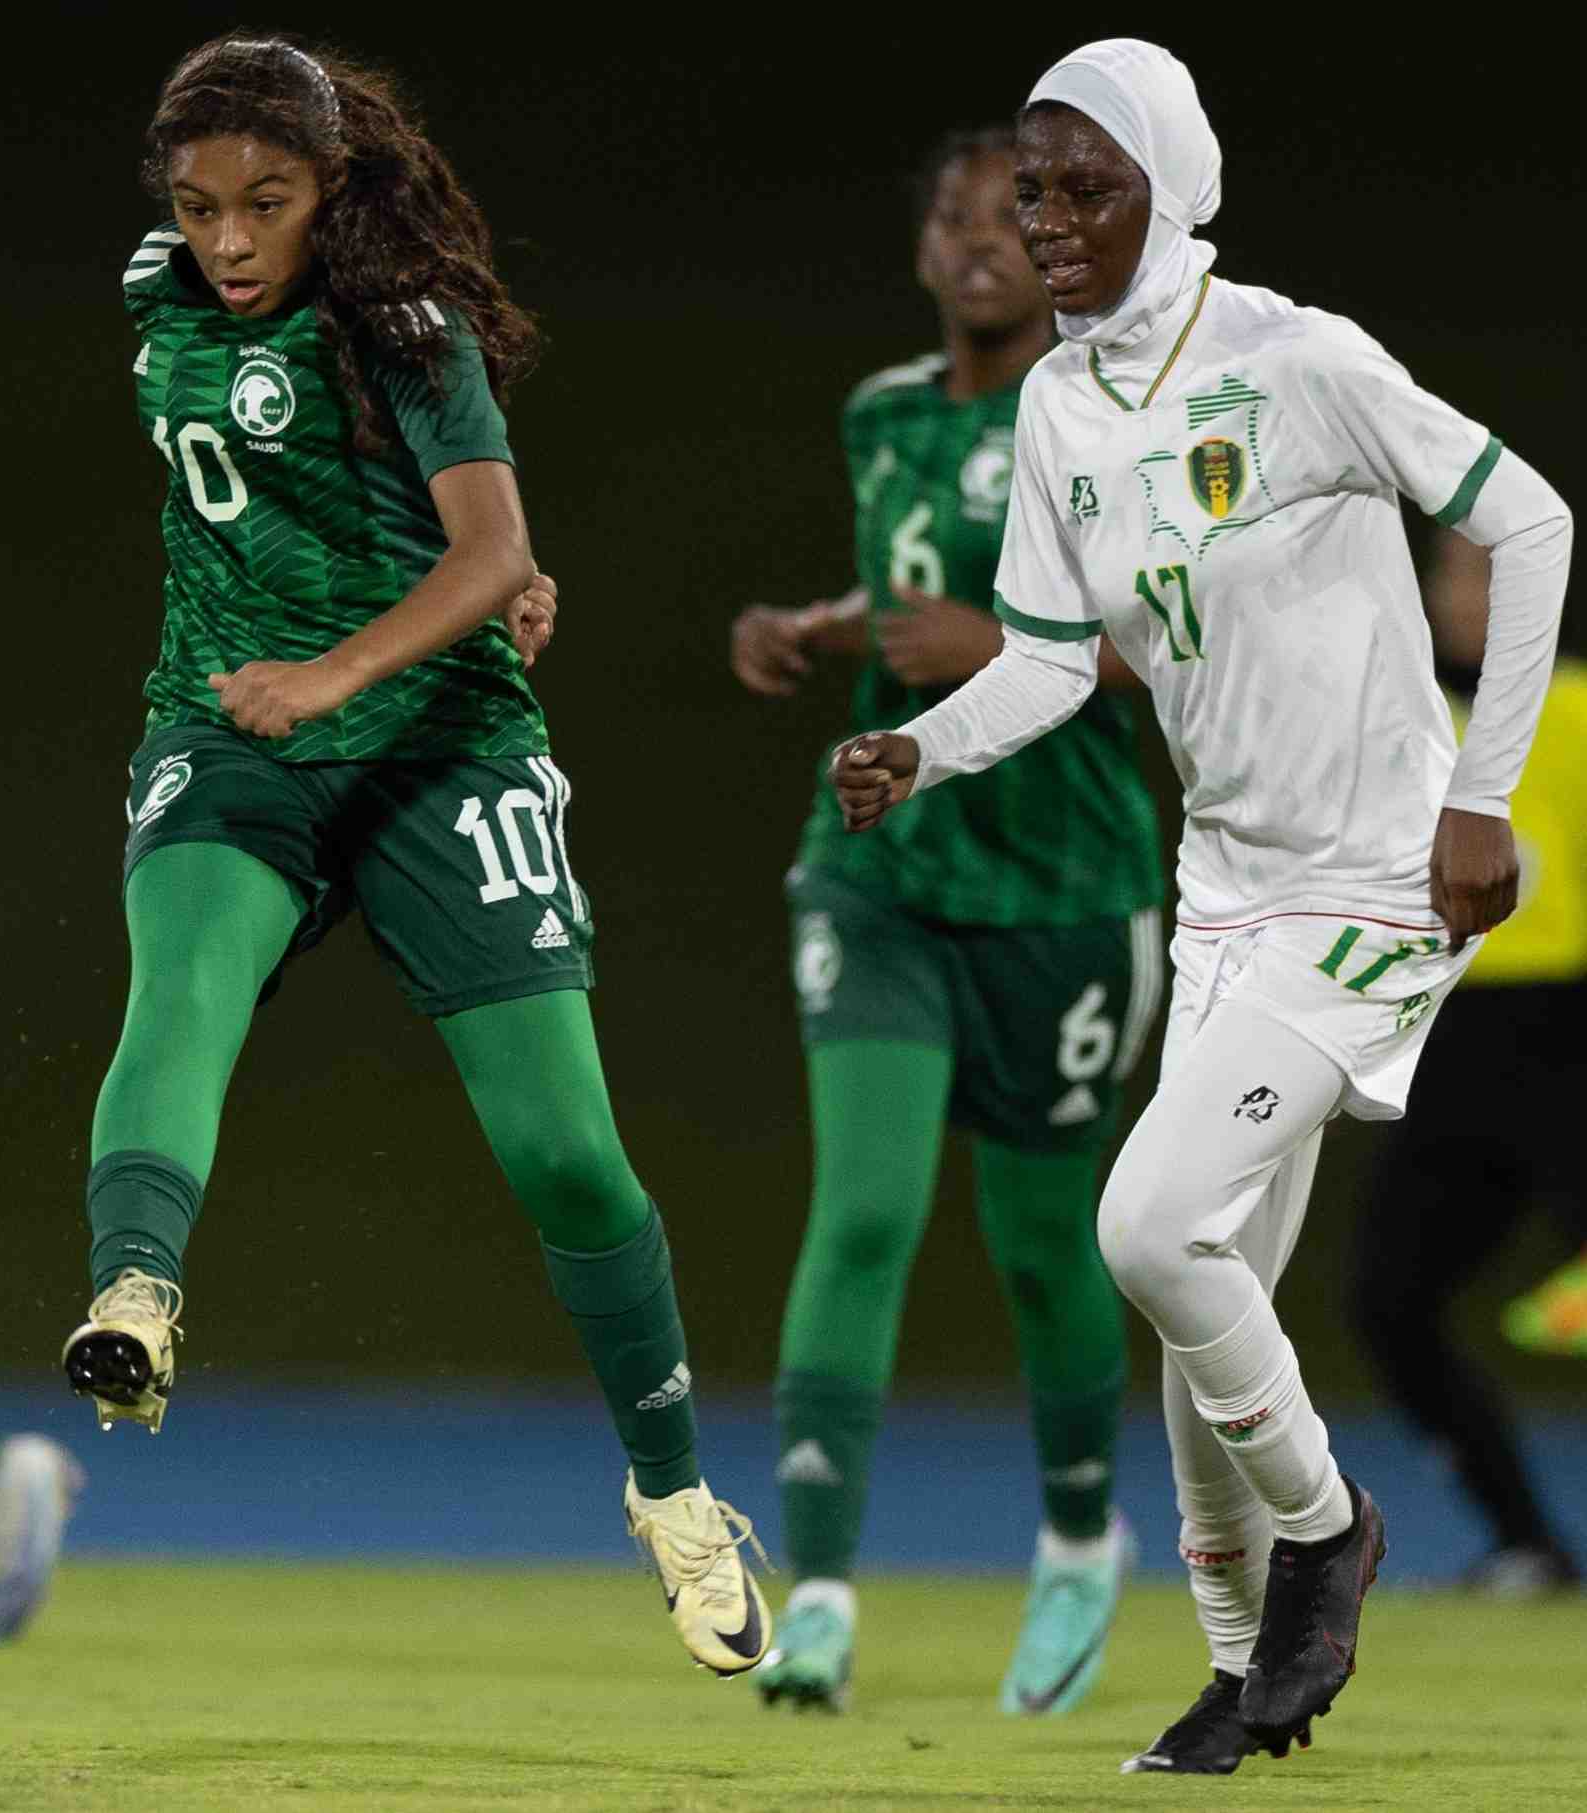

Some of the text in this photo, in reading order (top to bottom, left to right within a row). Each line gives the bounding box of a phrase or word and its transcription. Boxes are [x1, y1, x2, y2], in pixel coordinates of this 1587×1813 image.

[245, 440, 284, 454] SAUDI
[890, 501, 944, 599] 6
[1134, 564, 1205, 662] 17
[453, 788, 558, 905] 10
[531, 933, 570, 949] adidas
[1056, 982, 1115, 1083] 6
